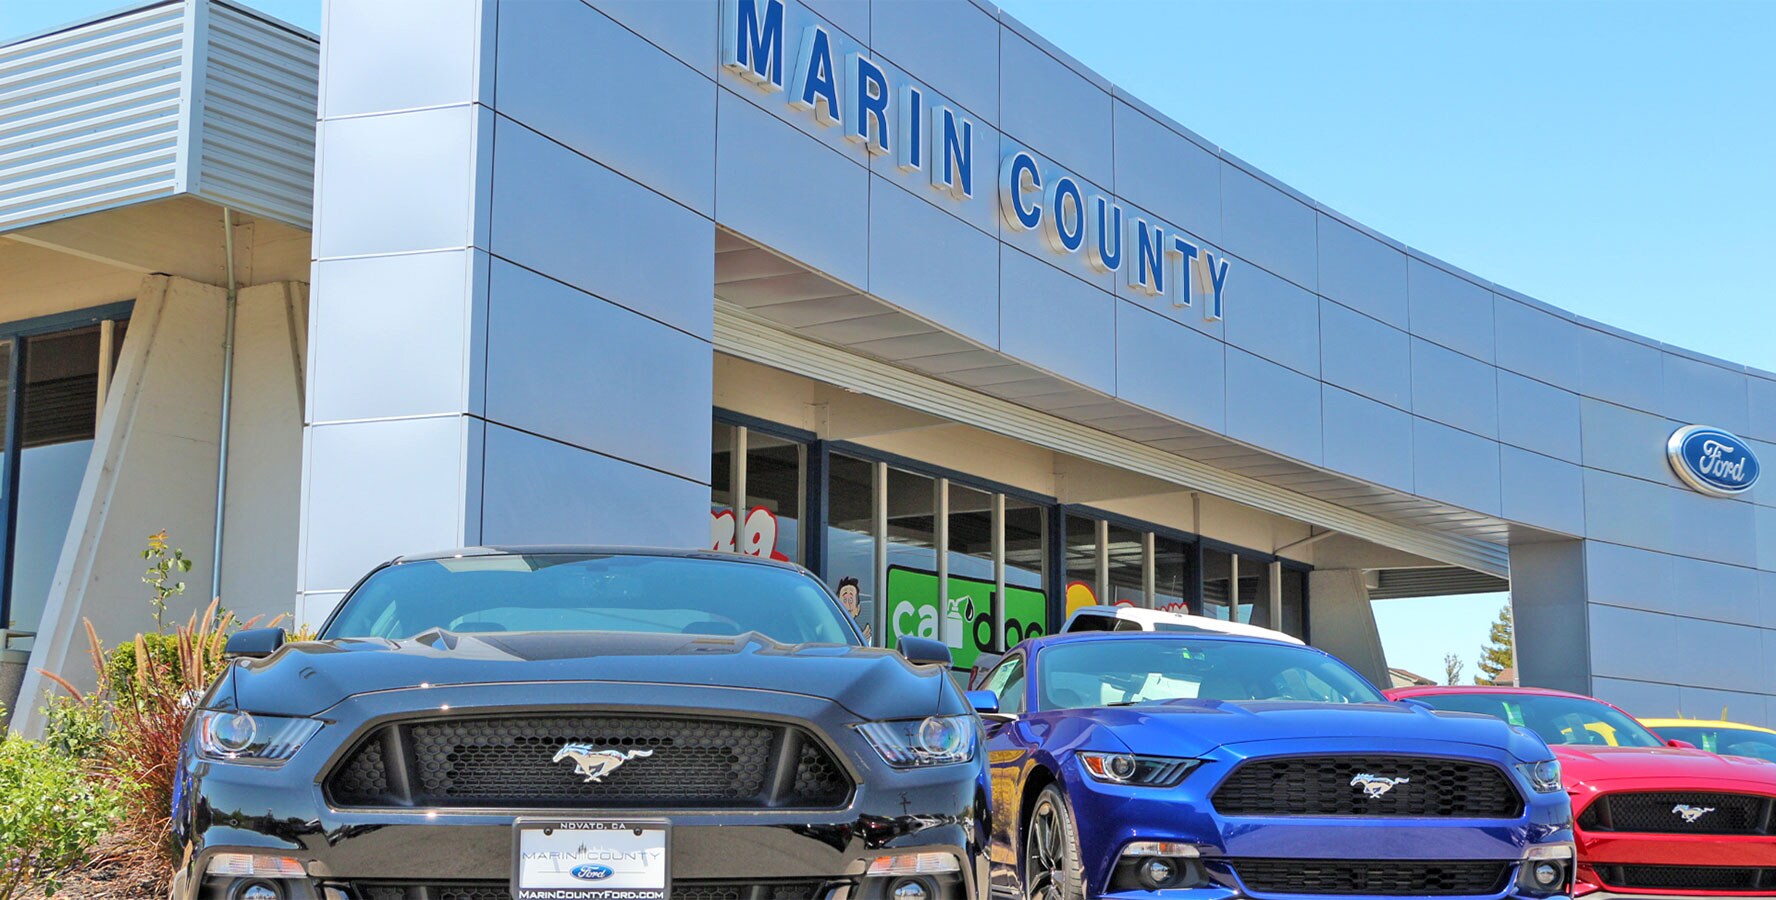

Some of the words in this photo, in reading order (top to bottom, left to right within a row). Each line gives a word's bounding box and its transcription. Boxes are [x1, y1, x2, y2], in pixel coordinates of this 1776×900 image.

[732, 0, 973, 199] MARIN
[1000, 151, 1230, 322] COUNTY
[1699, 439, 1746, 482] Ford
[560, 822, 608, 830] NOVATO,
[611, 822, 626, 830] CA
[522, 851, 577, 861] MARIN
[588, 851, 661, 861] COUNTY
[577, 865, 607, 879] Ford
